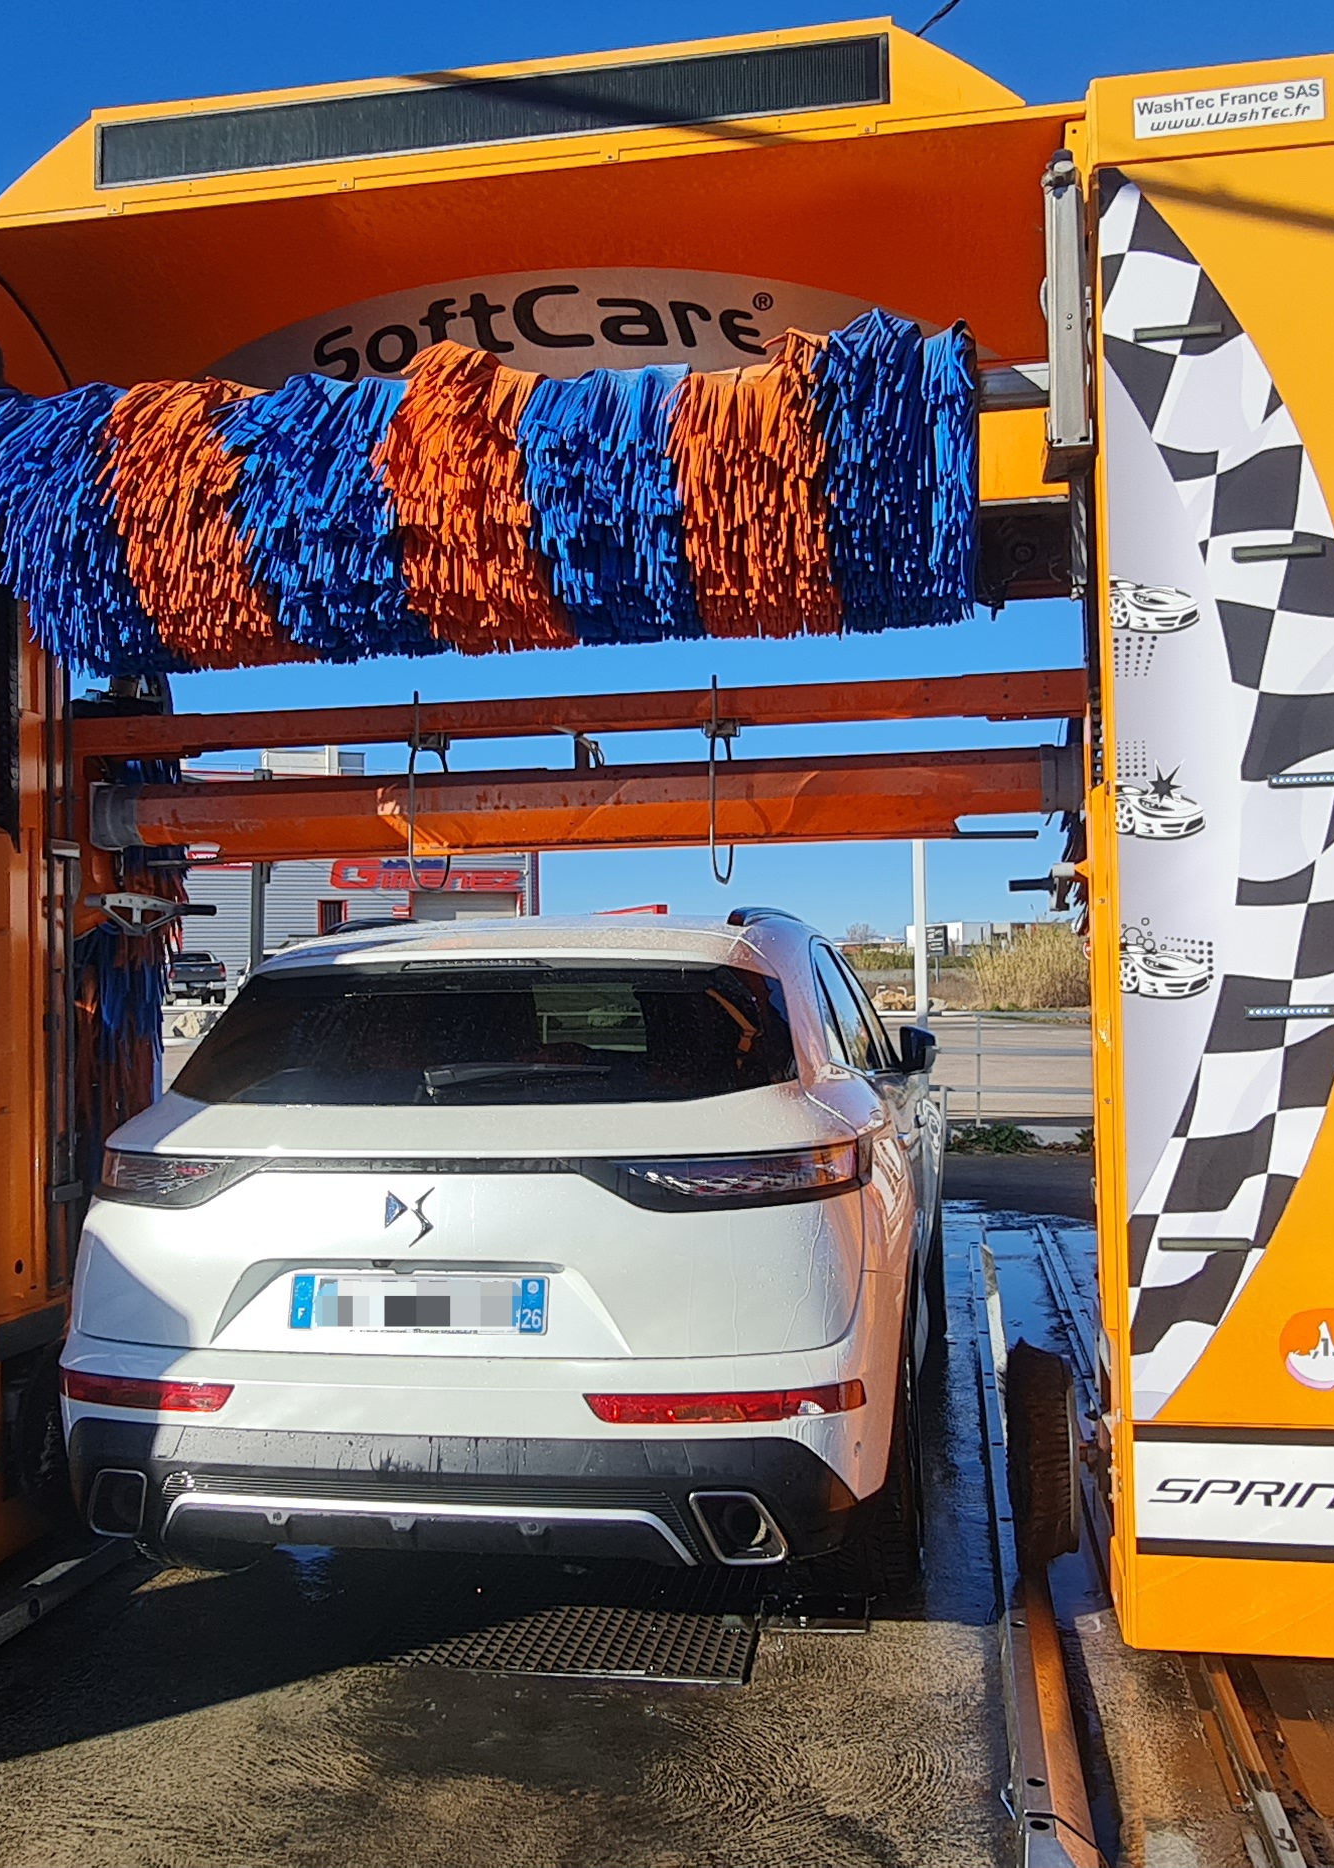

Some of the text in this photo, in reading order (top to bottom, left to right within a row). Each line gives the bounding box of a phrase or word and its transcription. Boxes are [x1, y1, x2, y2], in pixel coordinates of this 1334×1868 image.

[1136, 82, 1321, 117] WashTec France SAS
[1149, 103, 1311, 132] www.WashTec.fr
[297, 1306, 306, 1320] F
[521, 1308, 542, 1330] 26
